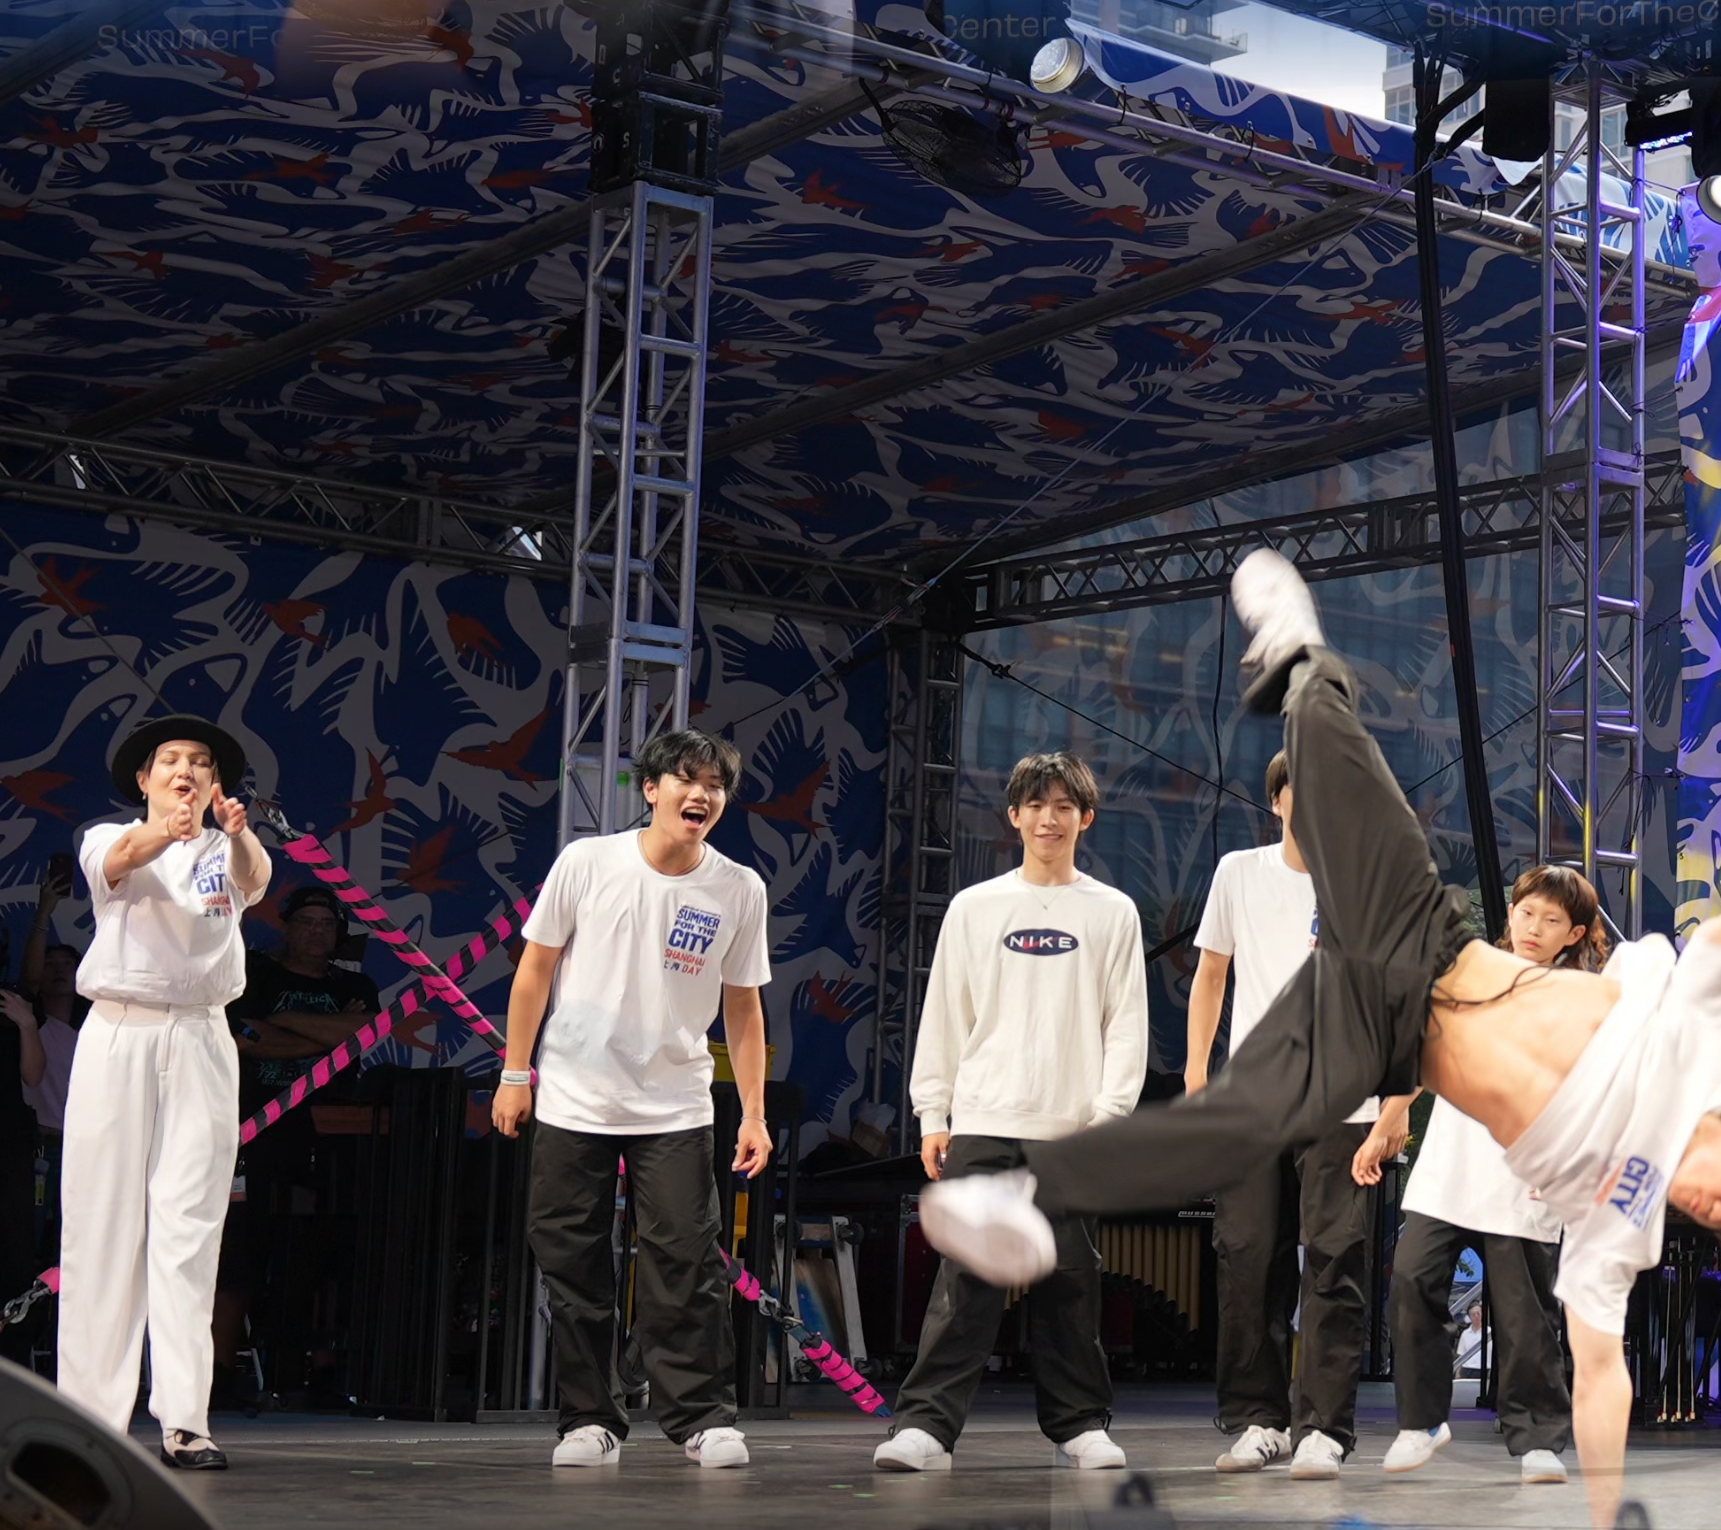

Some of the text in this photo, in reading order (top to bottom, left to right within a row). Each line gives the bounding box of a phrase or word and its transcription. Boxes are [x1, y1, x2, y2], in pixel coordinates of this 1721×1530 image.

[674, 918, 718, 937] FOR THE
[676, 908, 721, 930] SUMMER
[668, 928, 714, 955] CITY
[1009, 935, 1073, 949] NIKE
[663, 948, 707, 967] SHANGHAI
[681, 963, 703, 976] DAY
[1608, 1156, 1650, 1215] CITY
